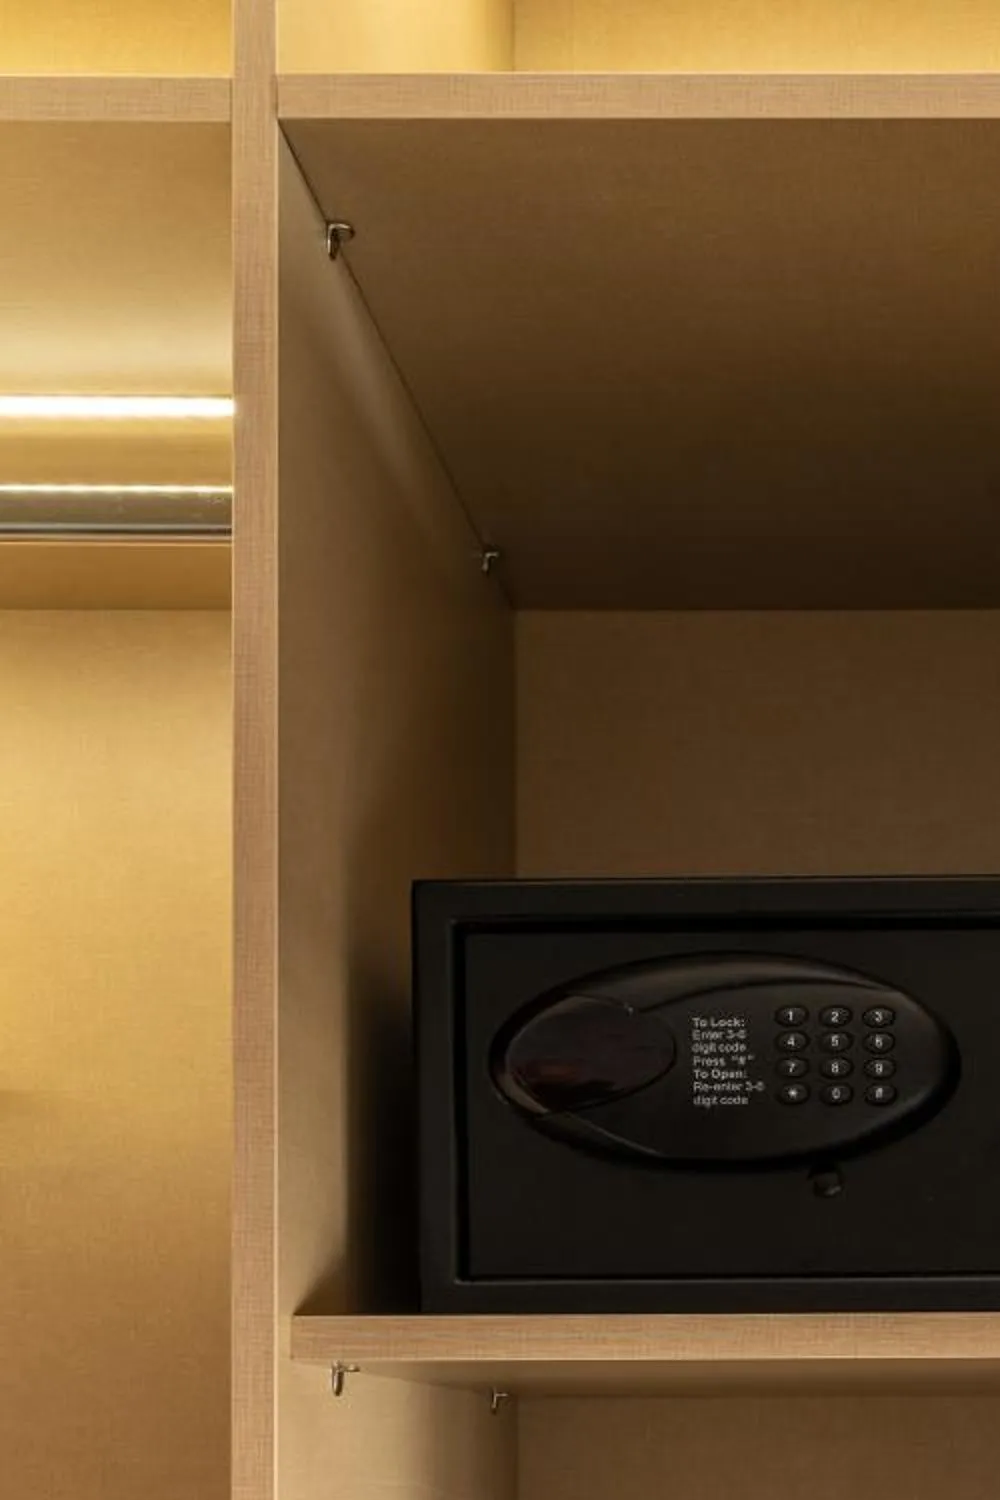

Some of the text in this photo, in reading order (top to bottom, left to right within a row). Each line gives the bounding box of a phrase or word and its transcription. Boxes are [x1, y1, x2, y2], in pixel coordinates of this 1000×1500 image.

[692, 1017, 745, 1028] To Lock:
[787, 1010, 883, 1023] 1 2 3
[787, 1034, 883, 1048] 4 5 6
[718, 1042, 747, 1053] code
[693, 1055, 727, 1067] Press
[693, 1068, 709, 1079] To
[788, 1062, 883, 1074] 7 8 9
[831, 1087, 841, 1099] 0
[720, 1095, 749, 1105] code
